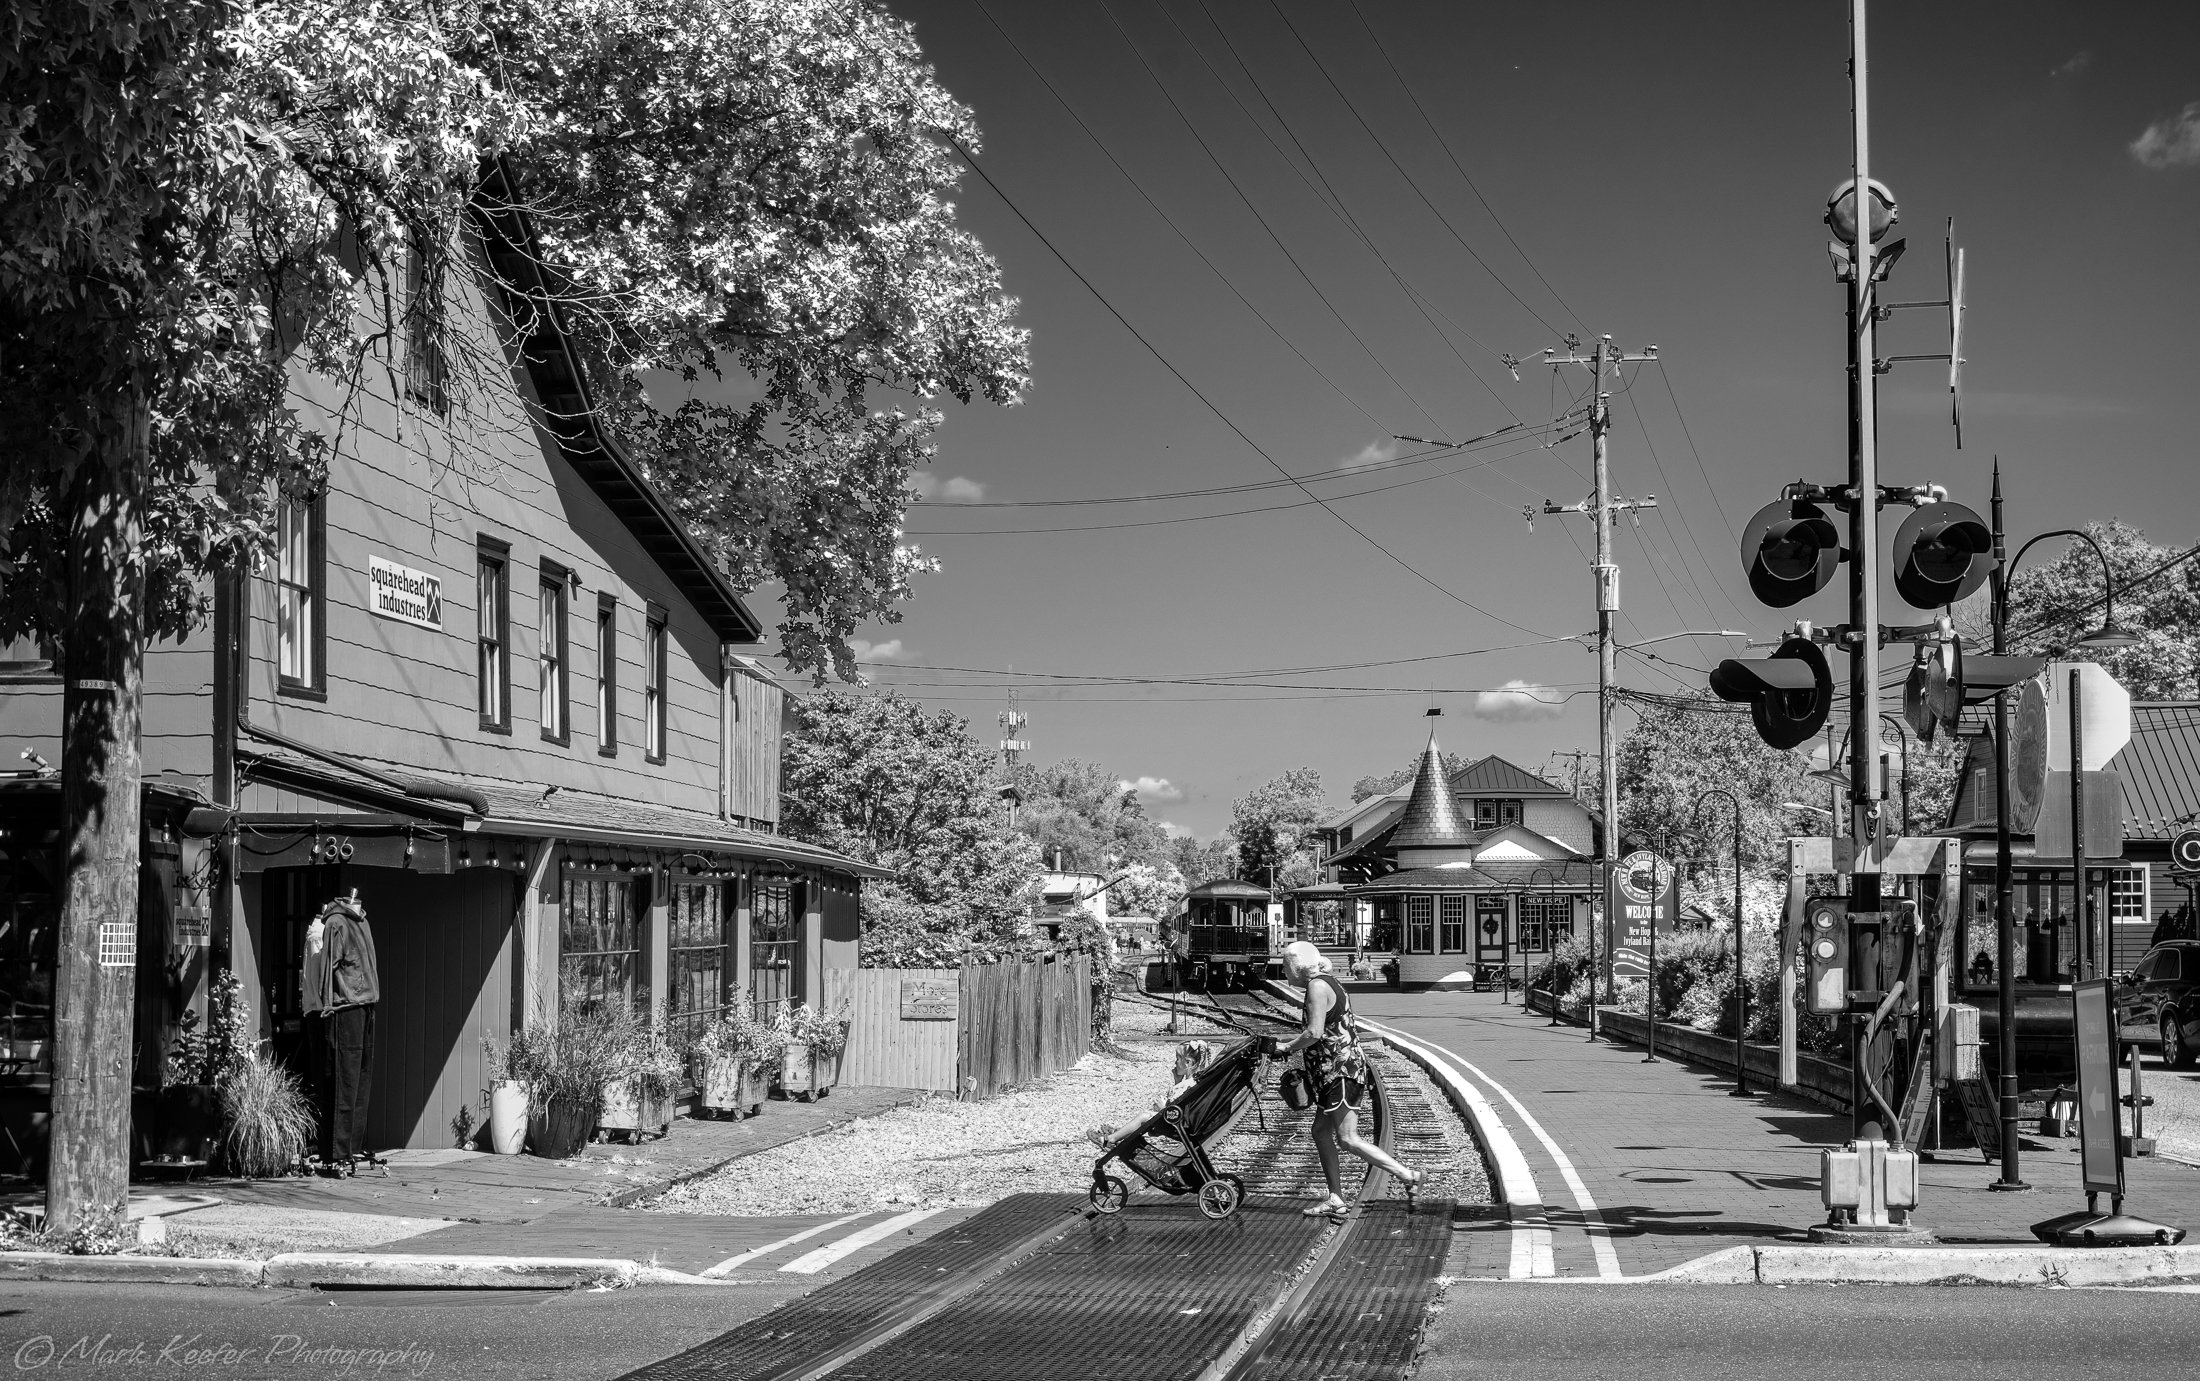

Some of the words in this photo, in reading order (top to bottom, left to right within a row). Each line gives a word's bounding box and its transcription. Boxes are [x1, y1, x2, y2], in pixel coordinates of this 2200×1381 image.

[379, 590, 426, 621] industries
[325, 836, 354, 857] 36
[1629, 927, 1640, 935] New
[1640, 927, 1651, 937] Hop
[1623, 937, 1642, 947] Ivyland
[911, 981, 947, 996] More
[910, 1004, 948, 1015] Stores
